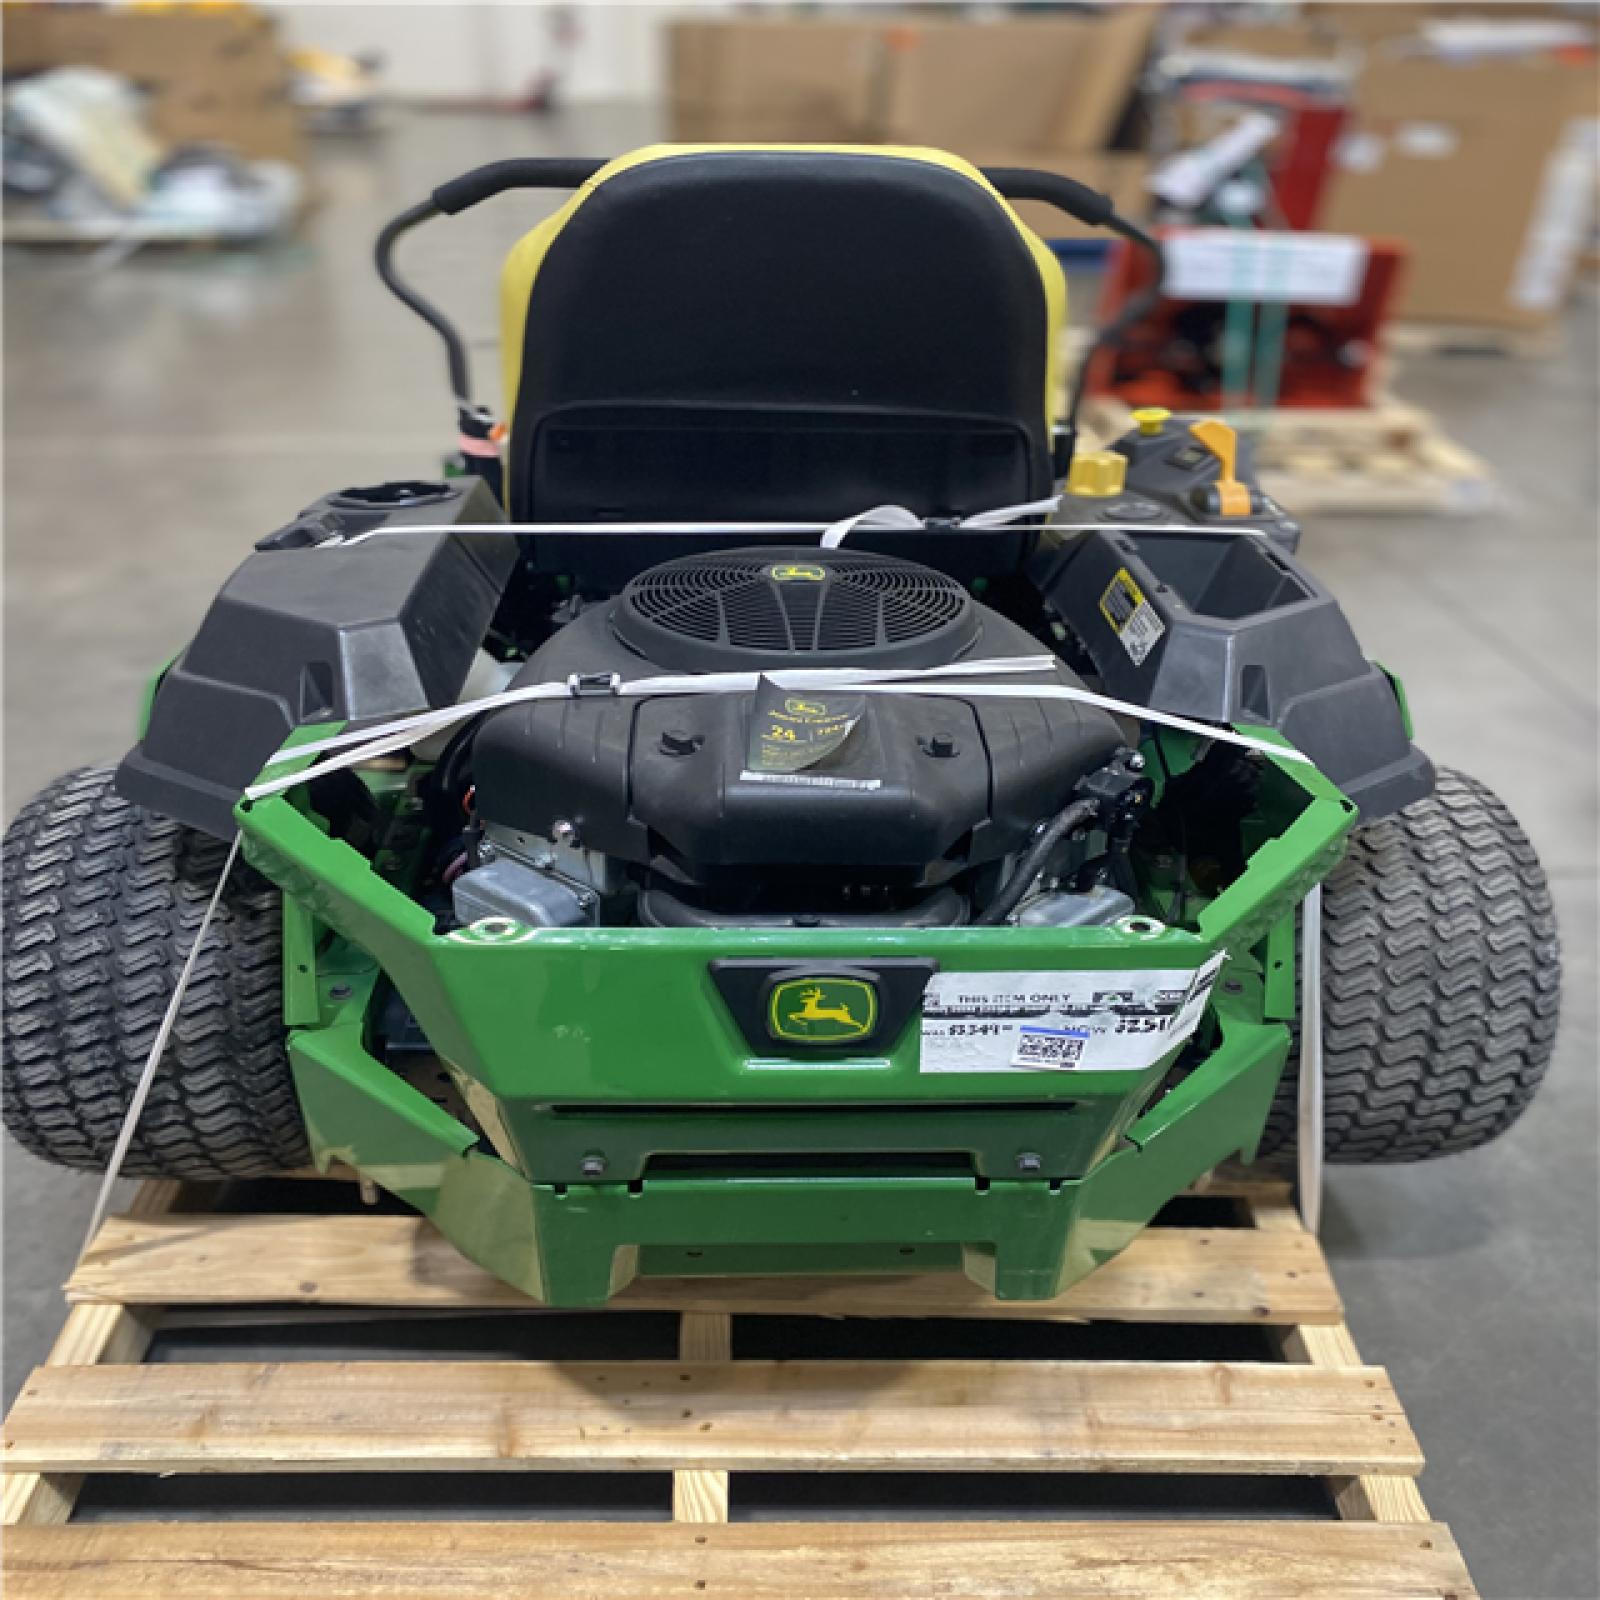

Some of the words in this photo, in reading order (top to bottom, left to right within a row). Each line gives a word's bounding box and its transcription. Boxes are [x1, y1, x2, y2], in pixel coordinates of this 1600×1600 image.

[959, 994, 988, 1003] THIS
[992, 994, 1026, 1003] ITEM
[1030, 993, 1071, 1003] ONLY
